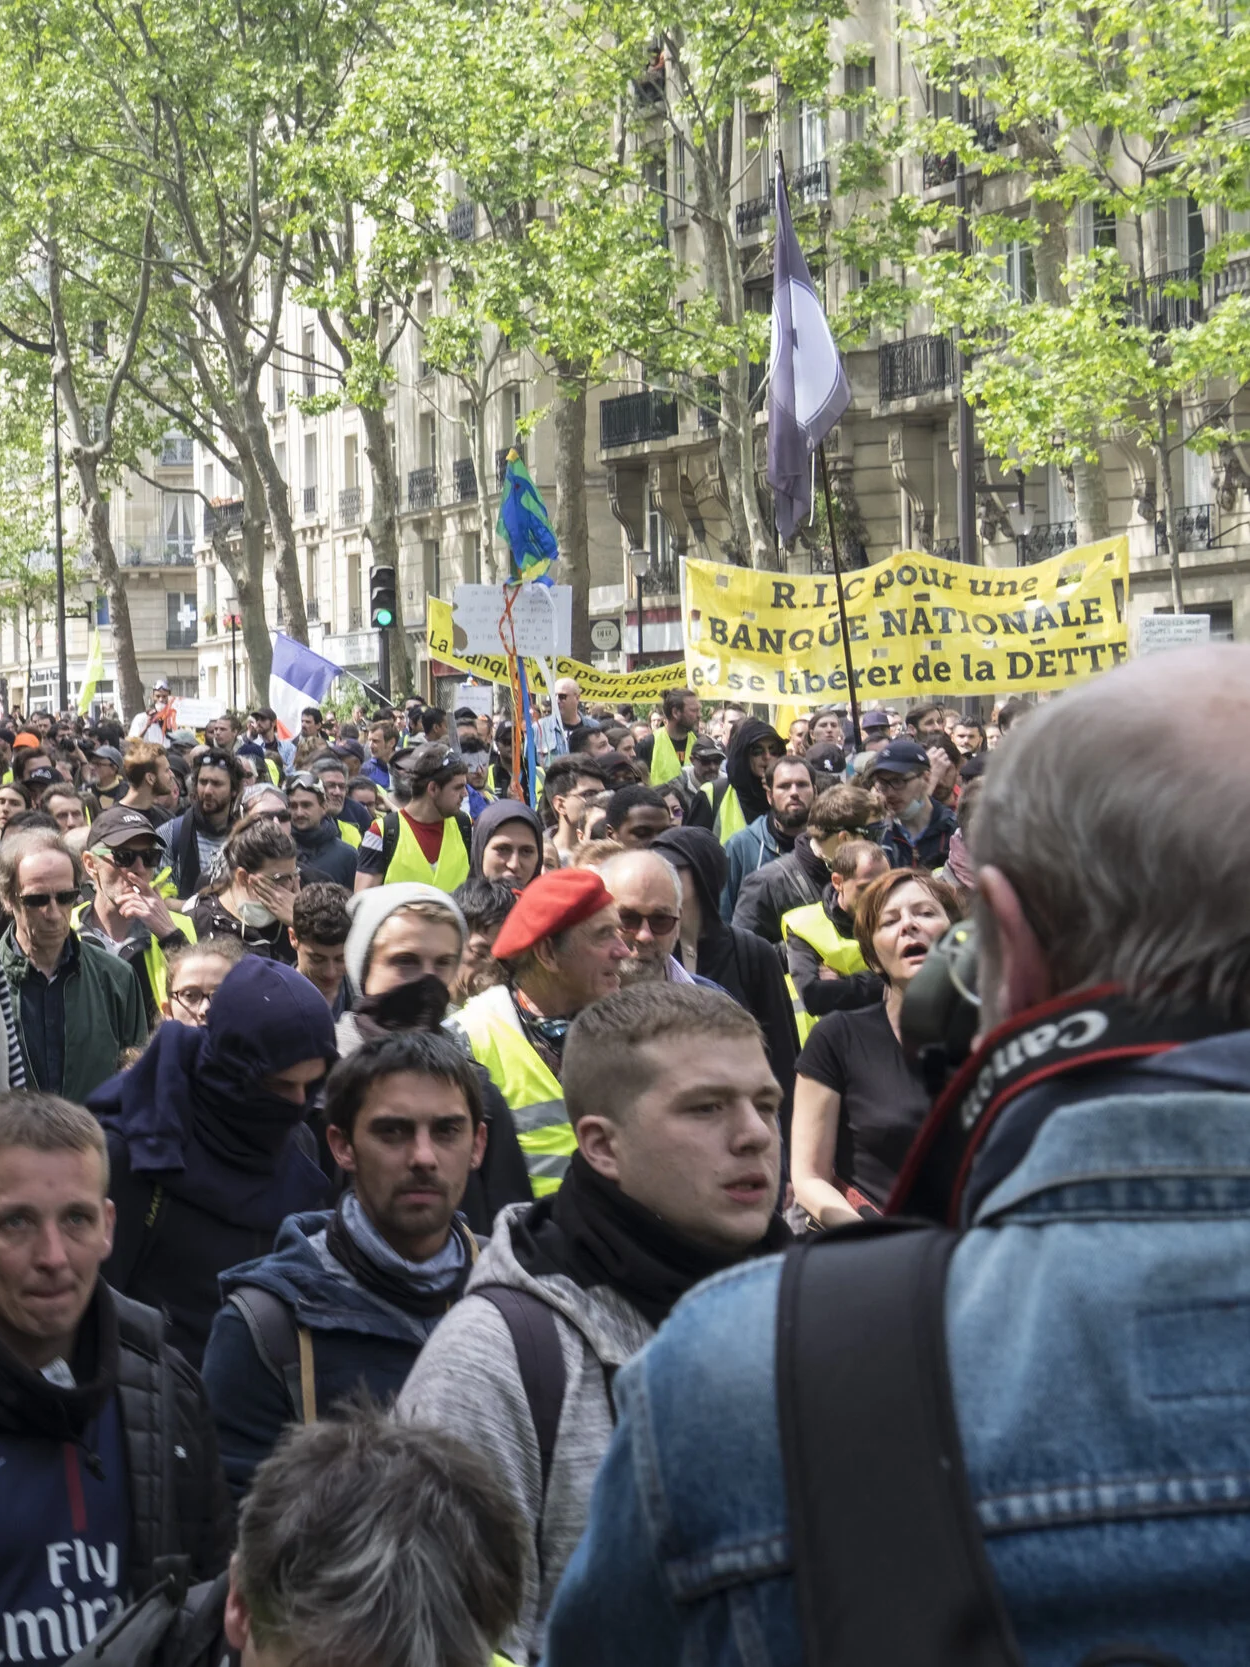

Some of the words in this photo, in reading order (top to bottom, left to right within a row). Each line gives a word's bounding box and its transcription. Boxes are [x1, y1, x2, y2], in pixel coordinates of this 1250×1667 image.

[872, 564, 958, 598] pour
[968, 576, 1039, 597] une
[429, 630, 449, 653] La
[708, 614, 869, 655] BANQUE
[879, 597, 1104, 638] NATIONALE
[574, 669, 623, 686] pour
[727, 671, 765, 691] se
[775, 663, 904, 695] libérer
[912, 654, 951, 683] de
[960, 653, 996, 682] la
[961, 1010, 1109, 1129] Canon
[46, 1538, 119, 1589] Fly
